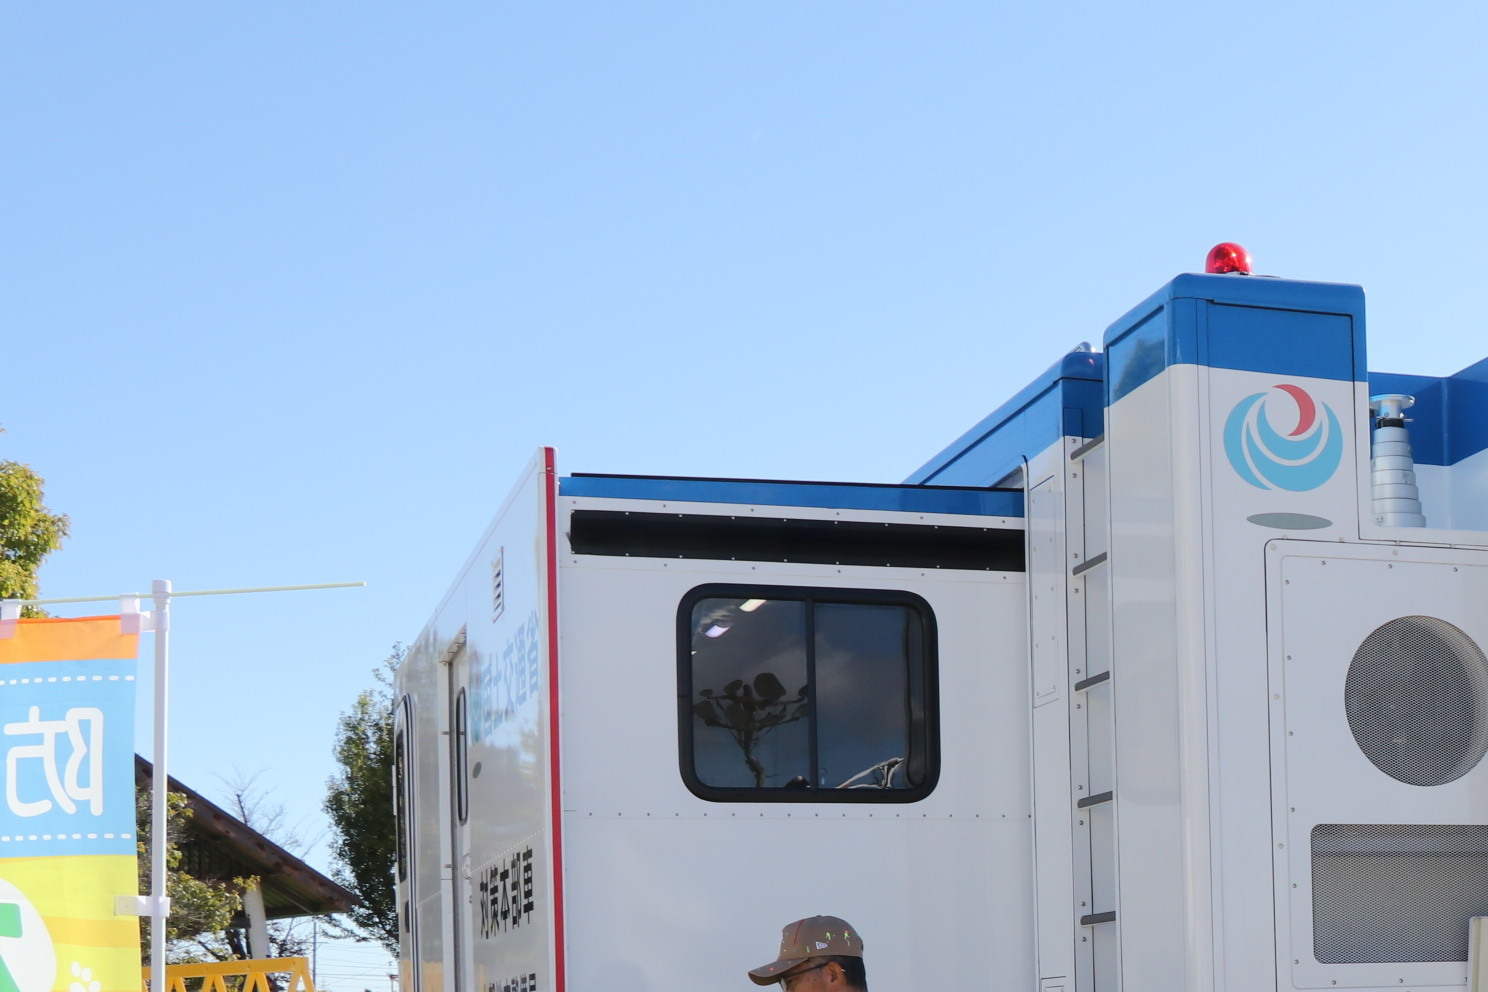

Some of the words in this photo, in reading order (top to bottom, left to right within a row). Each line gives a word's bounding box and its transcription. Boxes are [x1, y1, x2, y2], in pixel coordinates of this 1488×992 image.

[482, 608, 539, 740] 国土交通省
[479, 845, 535, 940] 対策本部車
